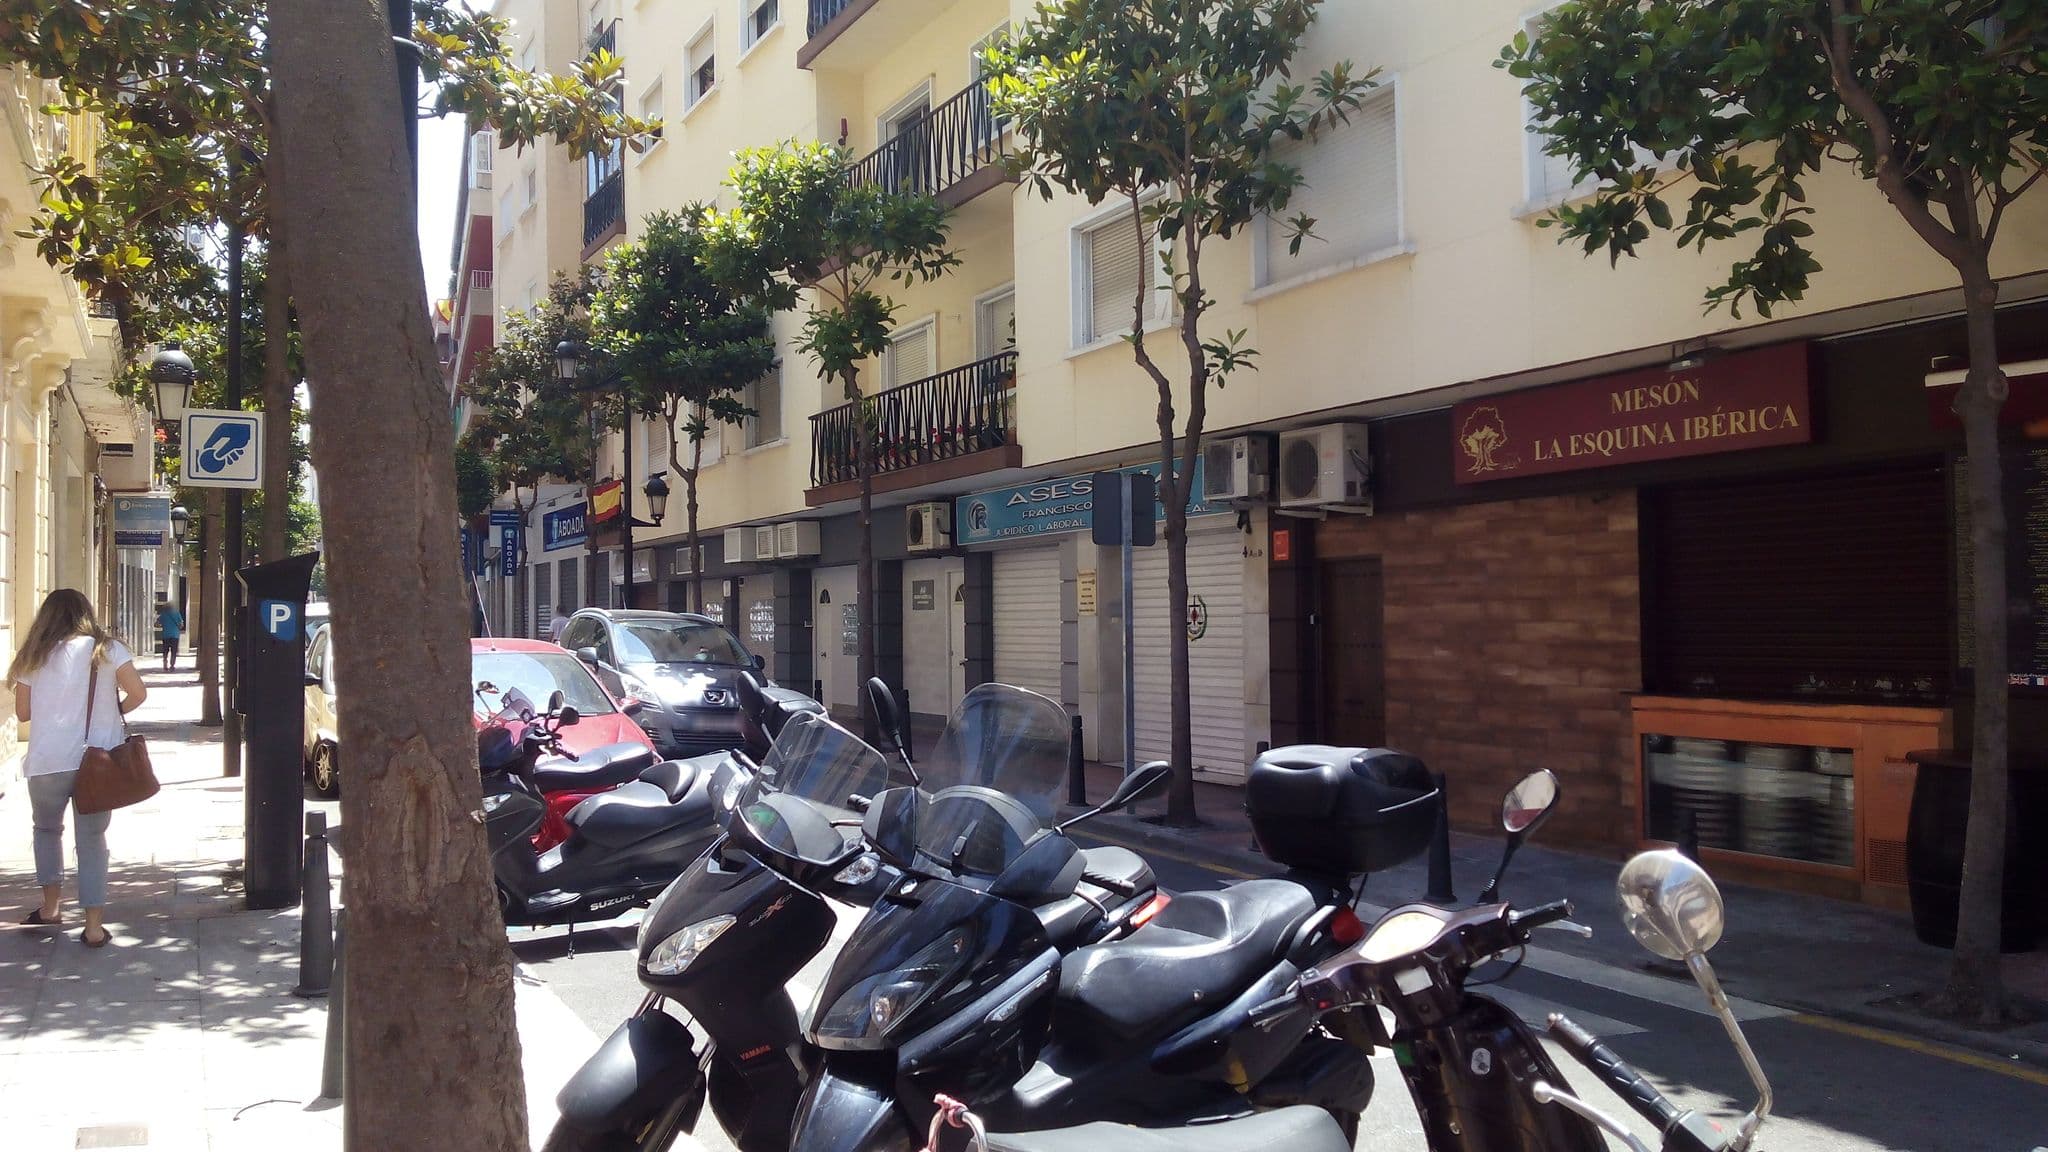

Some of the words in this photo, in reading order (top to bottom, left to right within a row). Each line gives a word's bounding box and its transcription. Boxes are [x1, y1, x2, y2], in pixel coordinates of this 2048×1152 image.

[1611, 376, 1703, 414] MESÓN
[1534, 437, 1564, 461] LA
[1570, 421, 1676, 457] ESQUINA
[1683, 403, 1800, 441] IBÉRICA
[1022, 501, 1093, 519] FRANCISCO
[1039, 518, 1086, 532] LABORAL
[270, 603, 291, 633] P
[590, 894, 635, 912] SUZUKI
